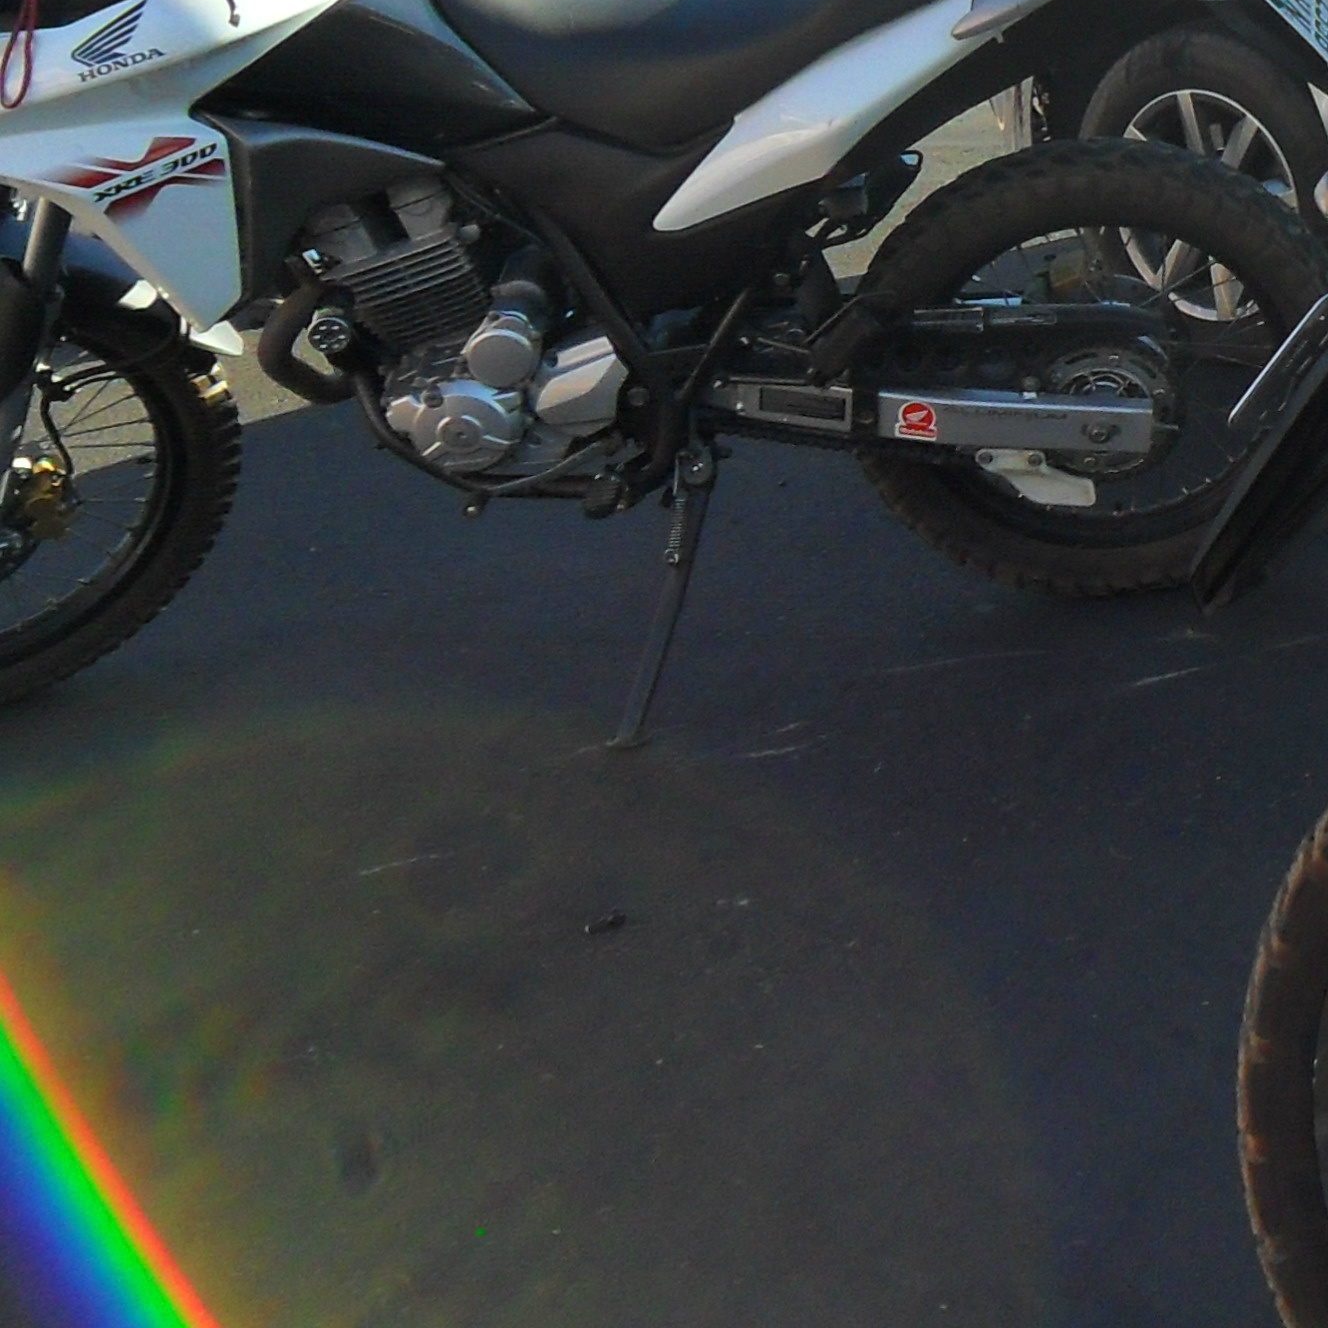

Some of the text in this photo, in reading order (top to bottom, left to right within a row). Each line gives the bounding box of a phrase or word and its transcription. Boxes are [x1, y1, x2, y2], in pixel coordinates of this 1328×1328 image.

[77, 47, 166, 83] HONDA
[93, 143, 218, 204] XRE 300
